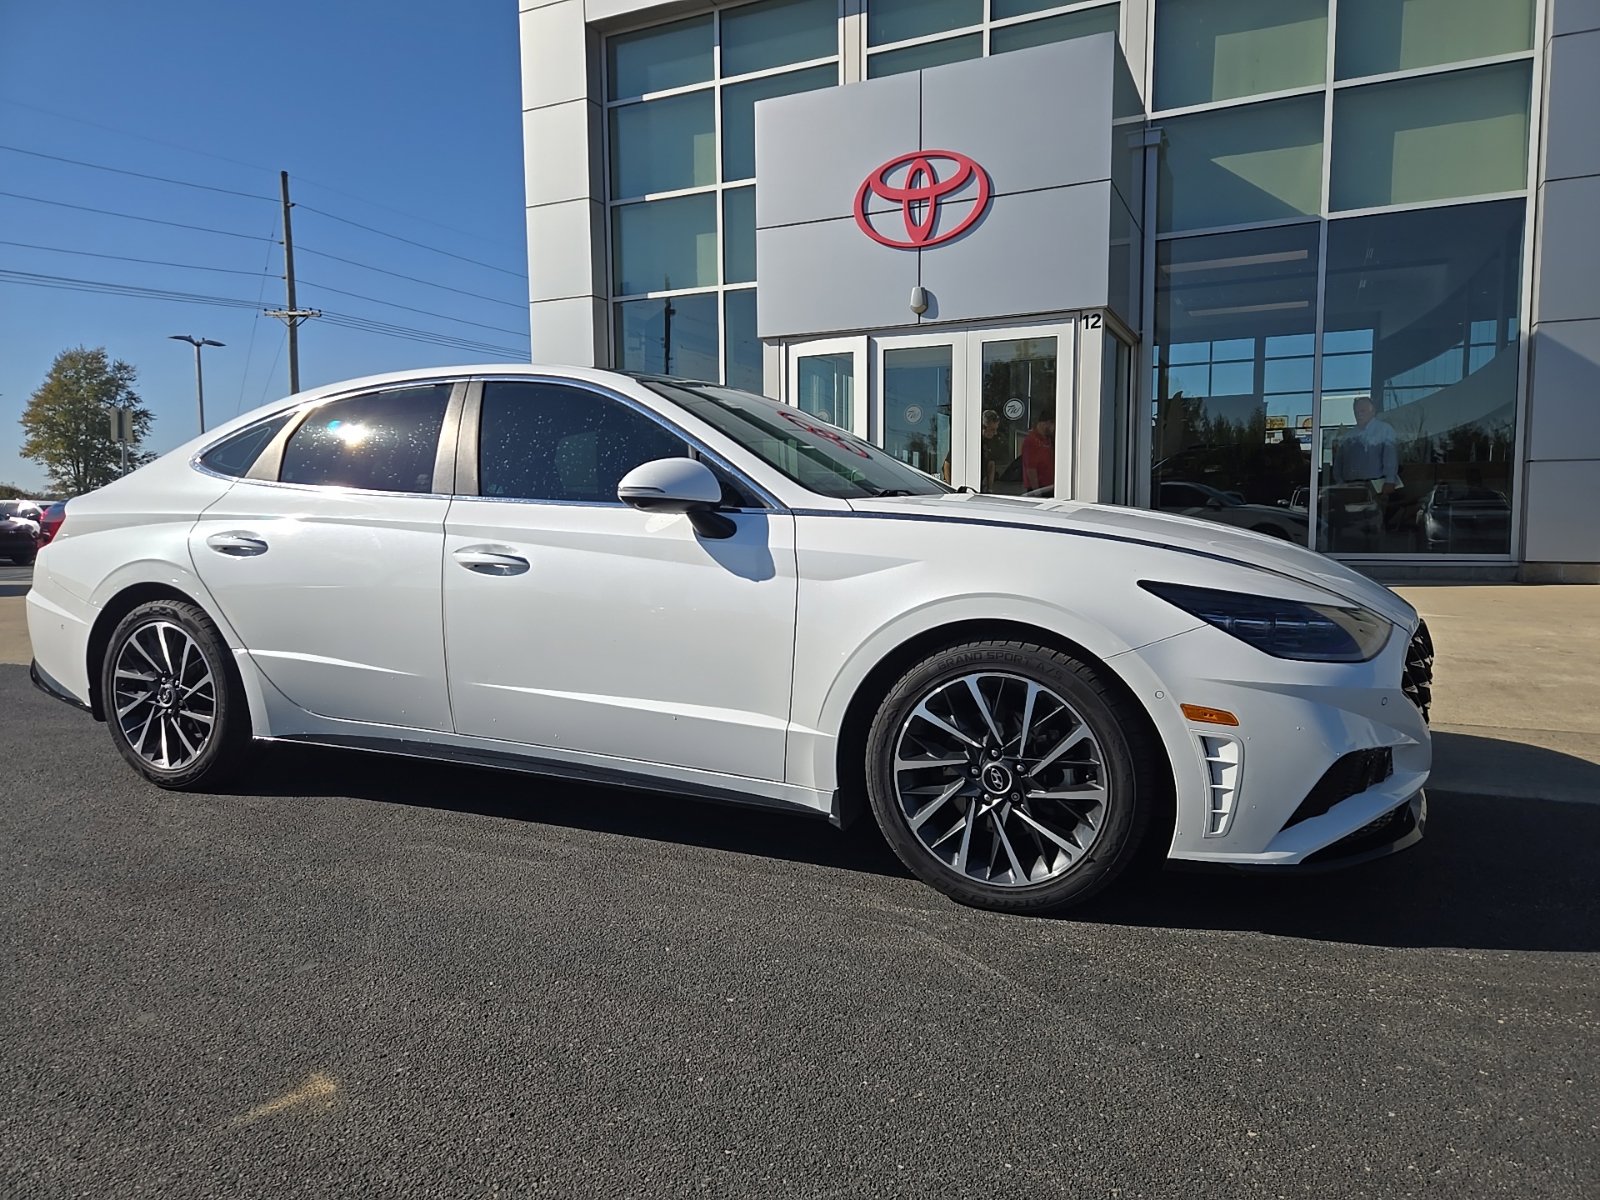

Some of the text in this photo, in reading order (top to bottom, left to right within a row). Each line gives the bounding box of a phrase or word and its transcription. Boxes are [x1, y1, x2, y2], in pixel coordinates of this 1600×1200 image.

[1083, 313, 1102, 329] 12
[937, 651, 982, 671] GRAND
[987, 651, 1030, 666] SPORT
